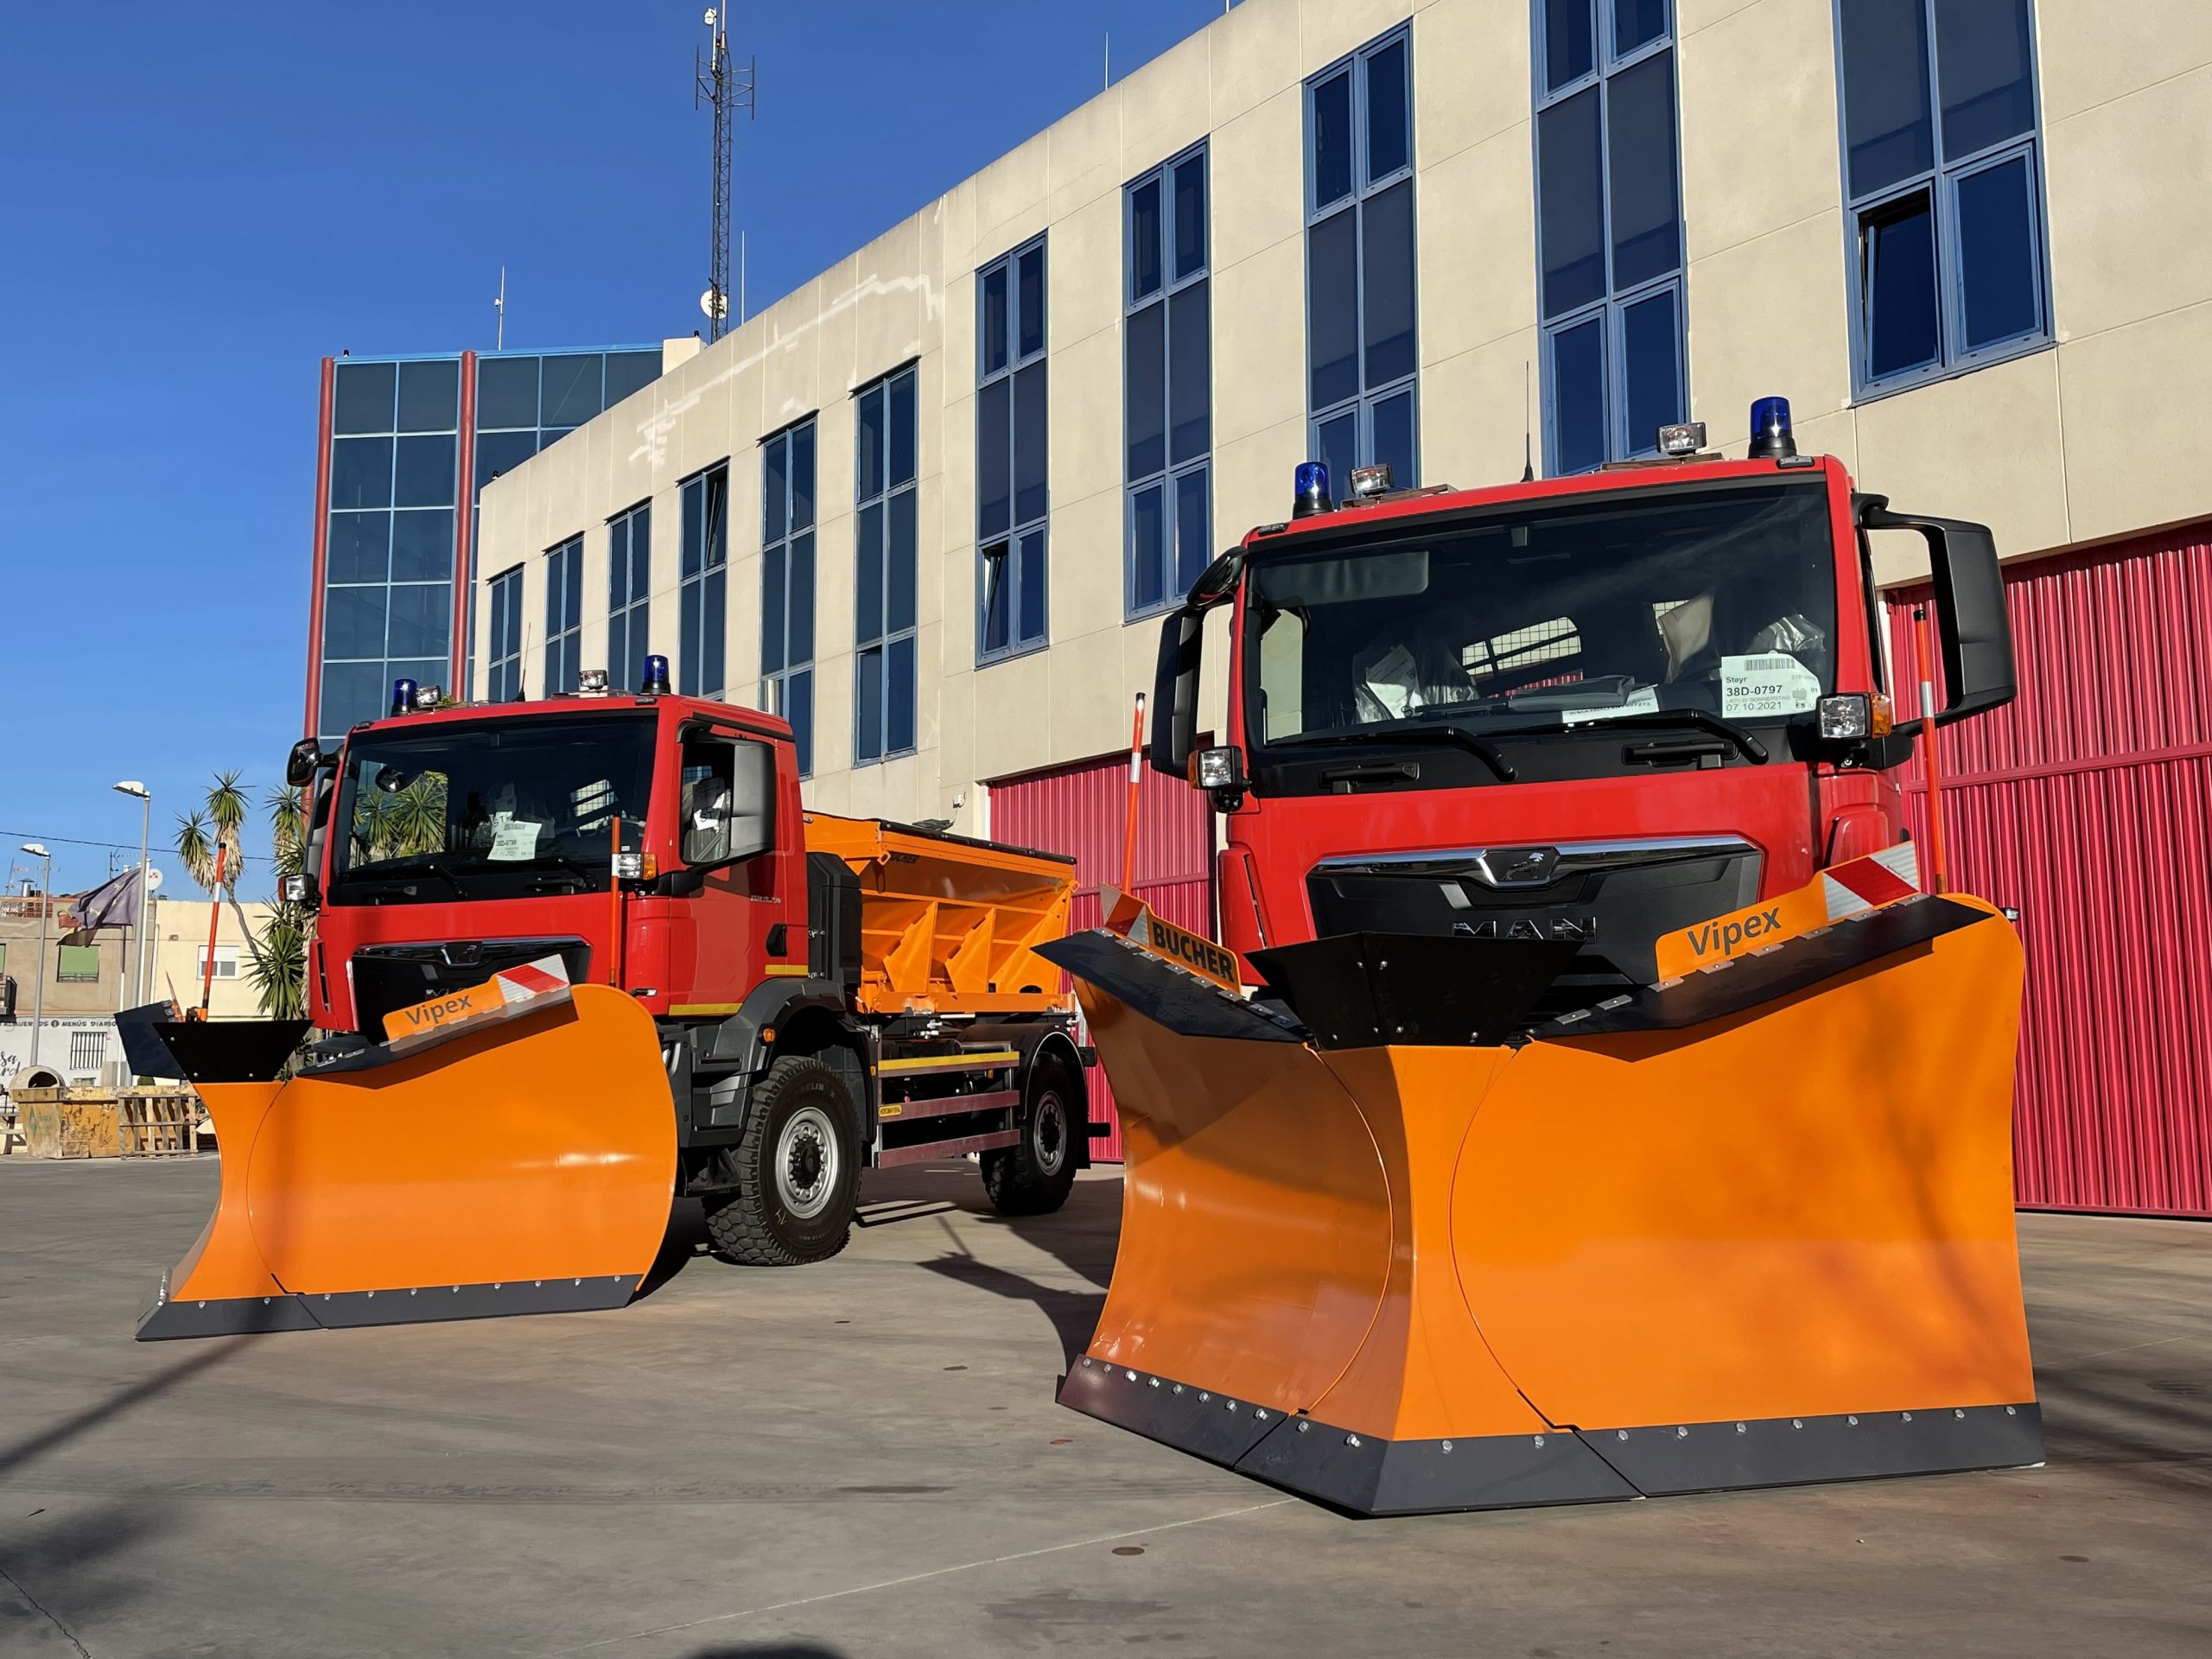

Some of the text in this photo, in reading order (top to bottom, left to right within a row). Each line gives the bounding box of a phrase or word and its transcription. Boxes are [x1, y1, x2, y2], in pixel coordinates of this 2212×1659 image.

[1726, 685, 1783, 696] 38D-0797
[1688, 907, 1782, 956] Vipex
[1153, 921, 1234, 983] BUCHER
[404, 995, 472, 1025] Vipex
